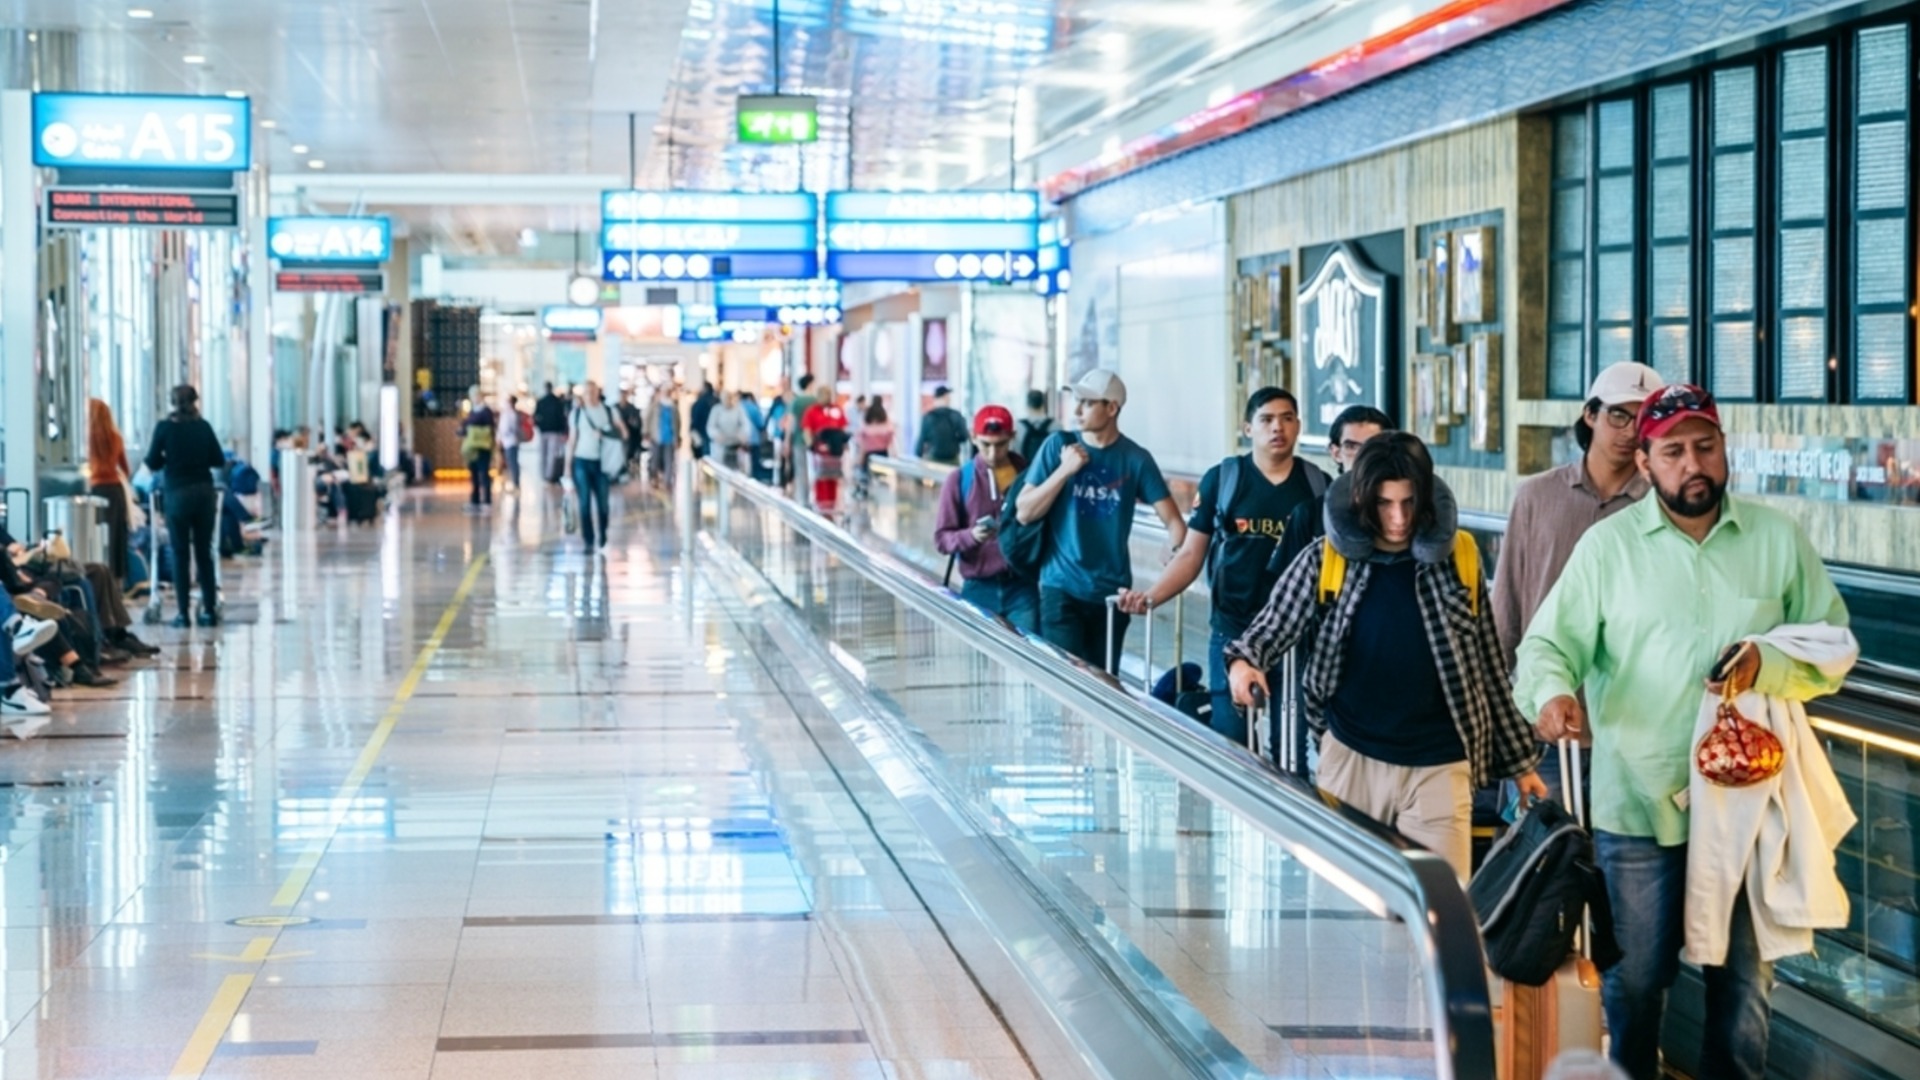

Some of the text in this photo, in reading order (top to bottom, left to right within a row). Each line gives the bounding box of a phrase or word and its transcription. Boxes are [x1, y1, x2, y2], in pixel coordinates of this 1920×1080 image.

[128, 111, 235, 162] A15
[53, 192, 195, 208] DUBAI INTERNATIONAL
[53, 208, 204, 223] Connecting the World
[320, 225, 385, 256] A14
[1072, 484, 1121, 502] NASA
[1235, 518, 1285, 535] DUBA
